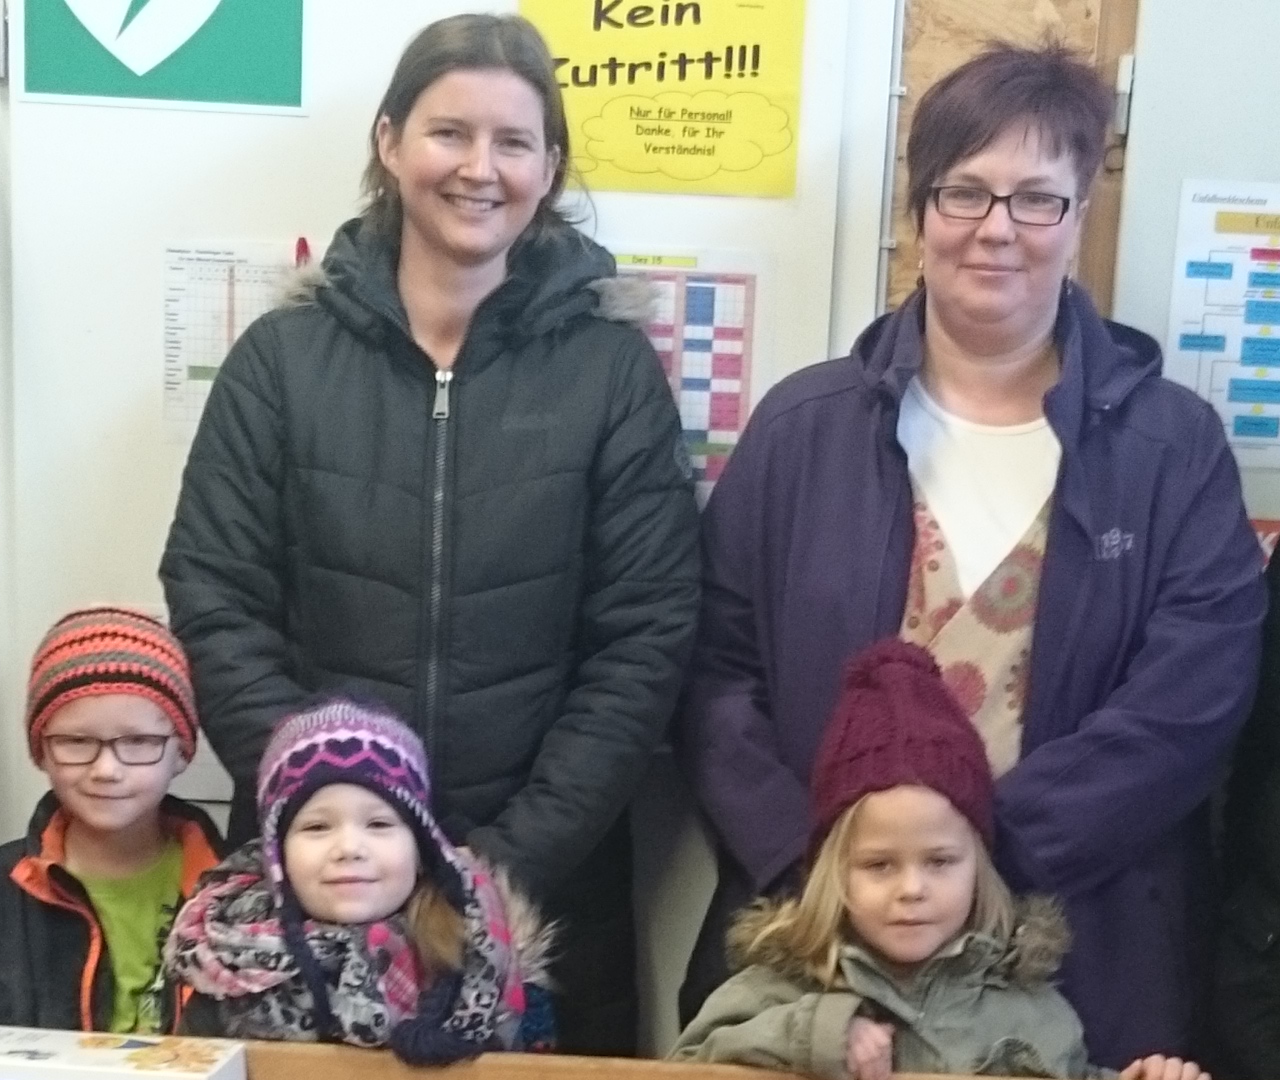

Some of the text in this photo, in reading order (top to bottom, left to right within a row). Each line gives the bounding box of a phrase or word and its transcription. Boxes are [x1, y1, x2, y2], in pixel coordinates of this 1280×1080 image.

[593, 0, 701, 32] Kein
[629, 105, 733, 121] Nur für Personal!
[682, 125, 700, 138] für
[705, 127, 725, 138] Ihr
[644, 142, 716, 156] Verständnis!
